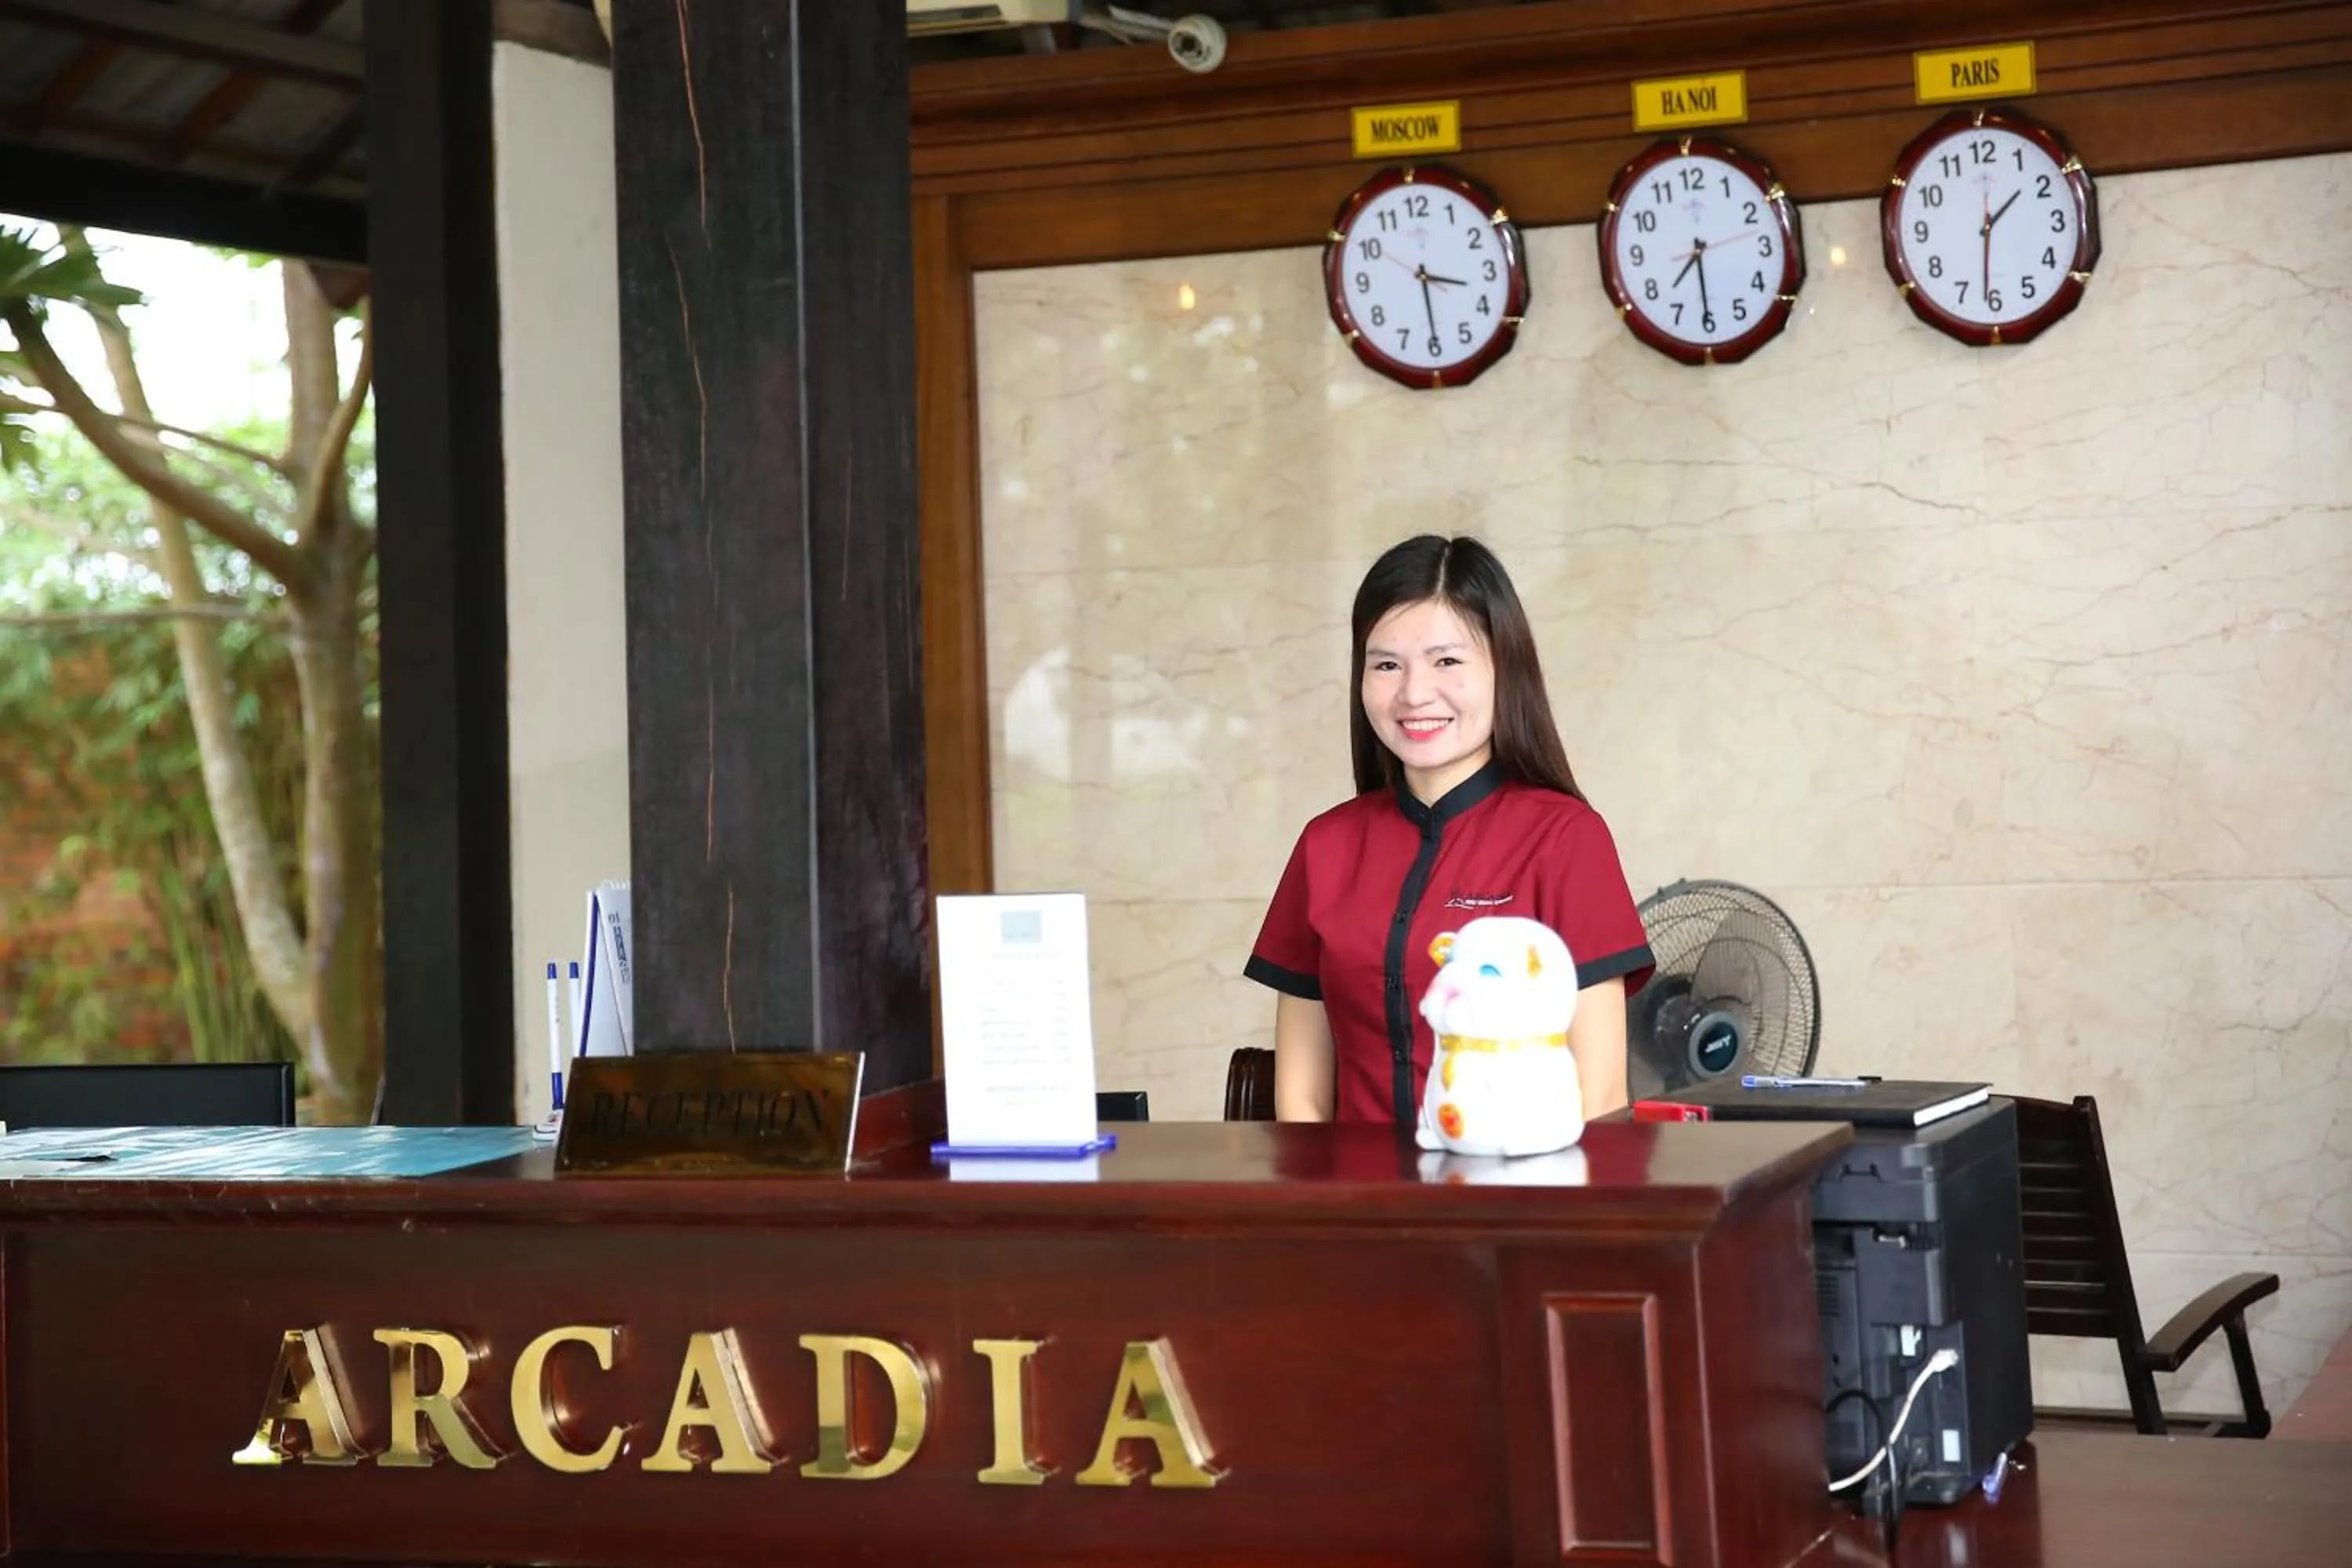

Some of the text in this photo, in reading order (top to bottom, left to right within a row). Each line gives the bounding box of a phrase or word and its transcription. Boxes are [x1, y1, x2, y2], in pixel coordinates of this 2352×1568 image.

[1951, 59, 2000, 88] PARIS
[1370, 115, 1441, 143] MOSCOW
[1969, 139, 1997, 164] 12
[2012, 147, 2024, 172] 1
[1938, 154, 1962, 179] 11
[1679, 167, 1705, 191] 12
[1720, 176, 1730, 199] 1
[2035, 174, 2052, 199] 2
[1650, 180, 1672, 205] 11
[1918, 184, 1944, 209] 10
[1403, 195, 1429, 218] 12
[1444, 203, 1454, 225] 1
[1743, 201, 1759, 225] 2
[1377, 209, 1397, 231] 11
[1632, 210, 1657, 233] 10
[1914, 220, 1929, 244] 9
[2050, 209, 2067, 234] 3
[1359, 238, 1382, 260] 10
[1467, 227, 1483, 250] 2
[1758, 234, 1773, 259] 3
[1629, 245, 1644, 267] 9
[1928, 255, 1943, 279] 8
[2041, 245, 2057, 270] 4
[1356, 272, 1370, 294] 9
[1482, 260, 1497, 282] 3
[1750, 270, 1766, 293] 4
[1644, 278, 1659, 301] 8
[1954, 281, 1969, 304] 7
[2020, 275, 2036, 299] 5
[1475, 294, 1490, 316] 4
[1732, 297, 1747, 321] 5
[1987, 289, 2002, 313] 6
[1370, 305, 1385, 327] 8
[1669, 302, 1685, 326] 7
[1701, 311, 1717, 334] 6
[1396, 328, 1410, 350] 7
[1458, 321, 1472, 345] 5
[1428, 335, 1443, 358] 6
[590, 1089, 829, 1138] RECEPTION
[230, 1323, 1226, 1488] ARCADIA
